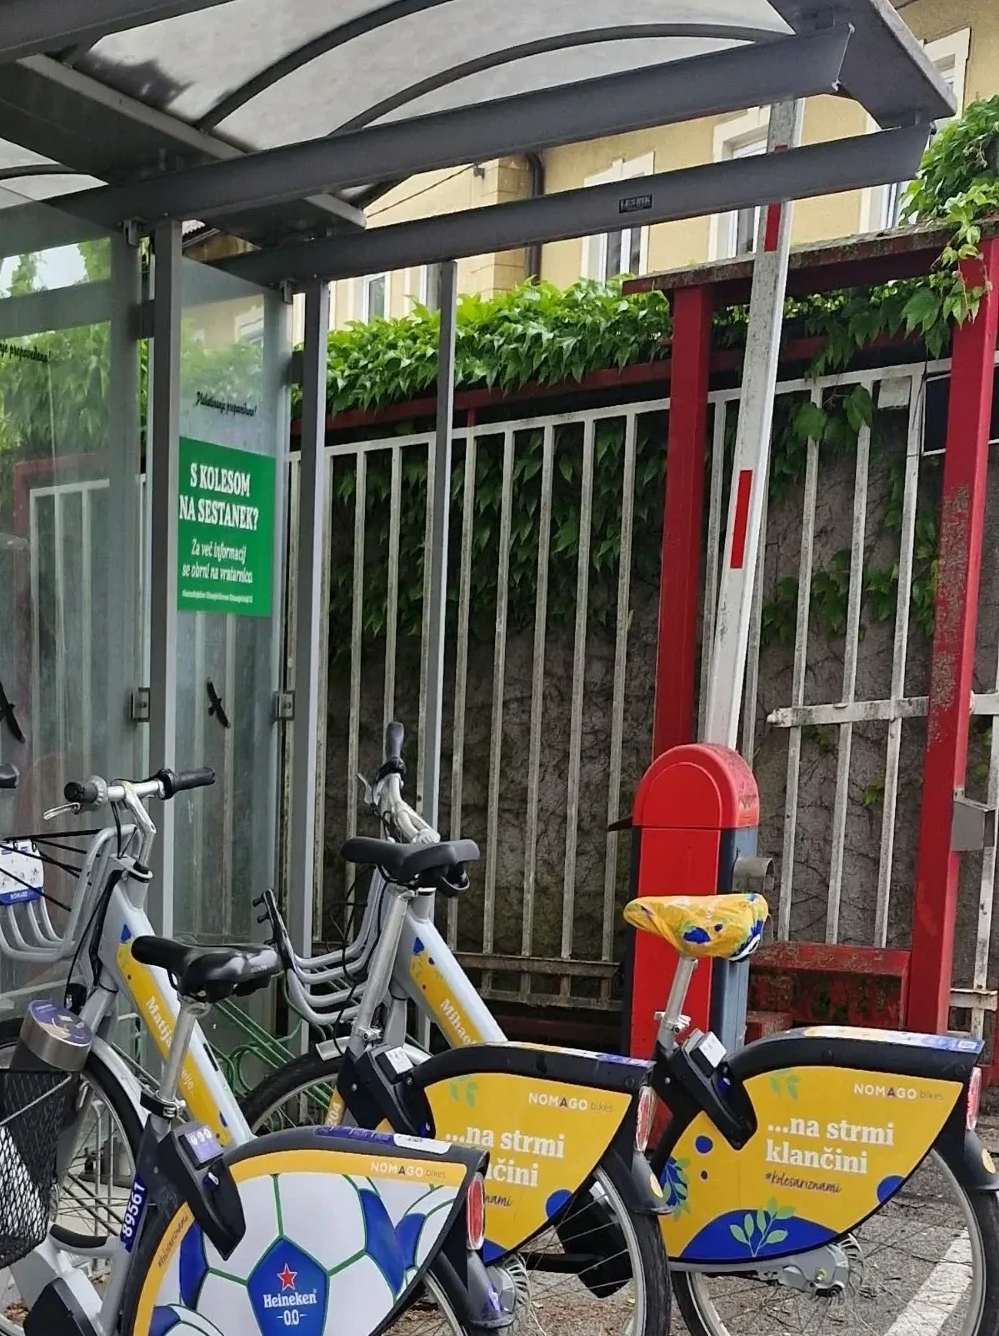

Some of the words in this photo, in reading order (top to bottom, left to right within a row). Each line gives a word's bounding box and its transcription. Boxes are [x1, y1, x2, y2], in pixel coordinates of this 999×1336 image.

[190, 462, 198, 488] S
[199, 464, 251, 498] KOLESOM
[179, 494, 197, 521] NA
[197, 498, 259, 531] SESTANEK?
[191, 538, 200, 556] Za
[201, 541, 213, 557] več
[213, 542, 247, 565] informacij
[182, 563, 191, 577] se
[191, 561, 210, 579] obrni
[210, 566, 219, 580] na
[528, 1092, 588, 1111] NOMAGO
[590, 1101, 613, 1112] bikes
[854, 1083, 917, 1099] NOMAGO
[919, 1089, 944, 1101] bikes
[445, 1126, 494, 1147] ...na
[500, 1130, 565, 1158] strmi
[768, 1117, 820, 1138] ...na
[826, 1119, 895, 1146] strmi
[371, 1161, 424, 1177] NOMAGO
[426, 1169, 446, 1179] bikes
[765, 1138, 868, 1175] klančini
[764, 1170, 842, 1194] #kolesariznami
[122, 1181, 146, 1238] 89561
